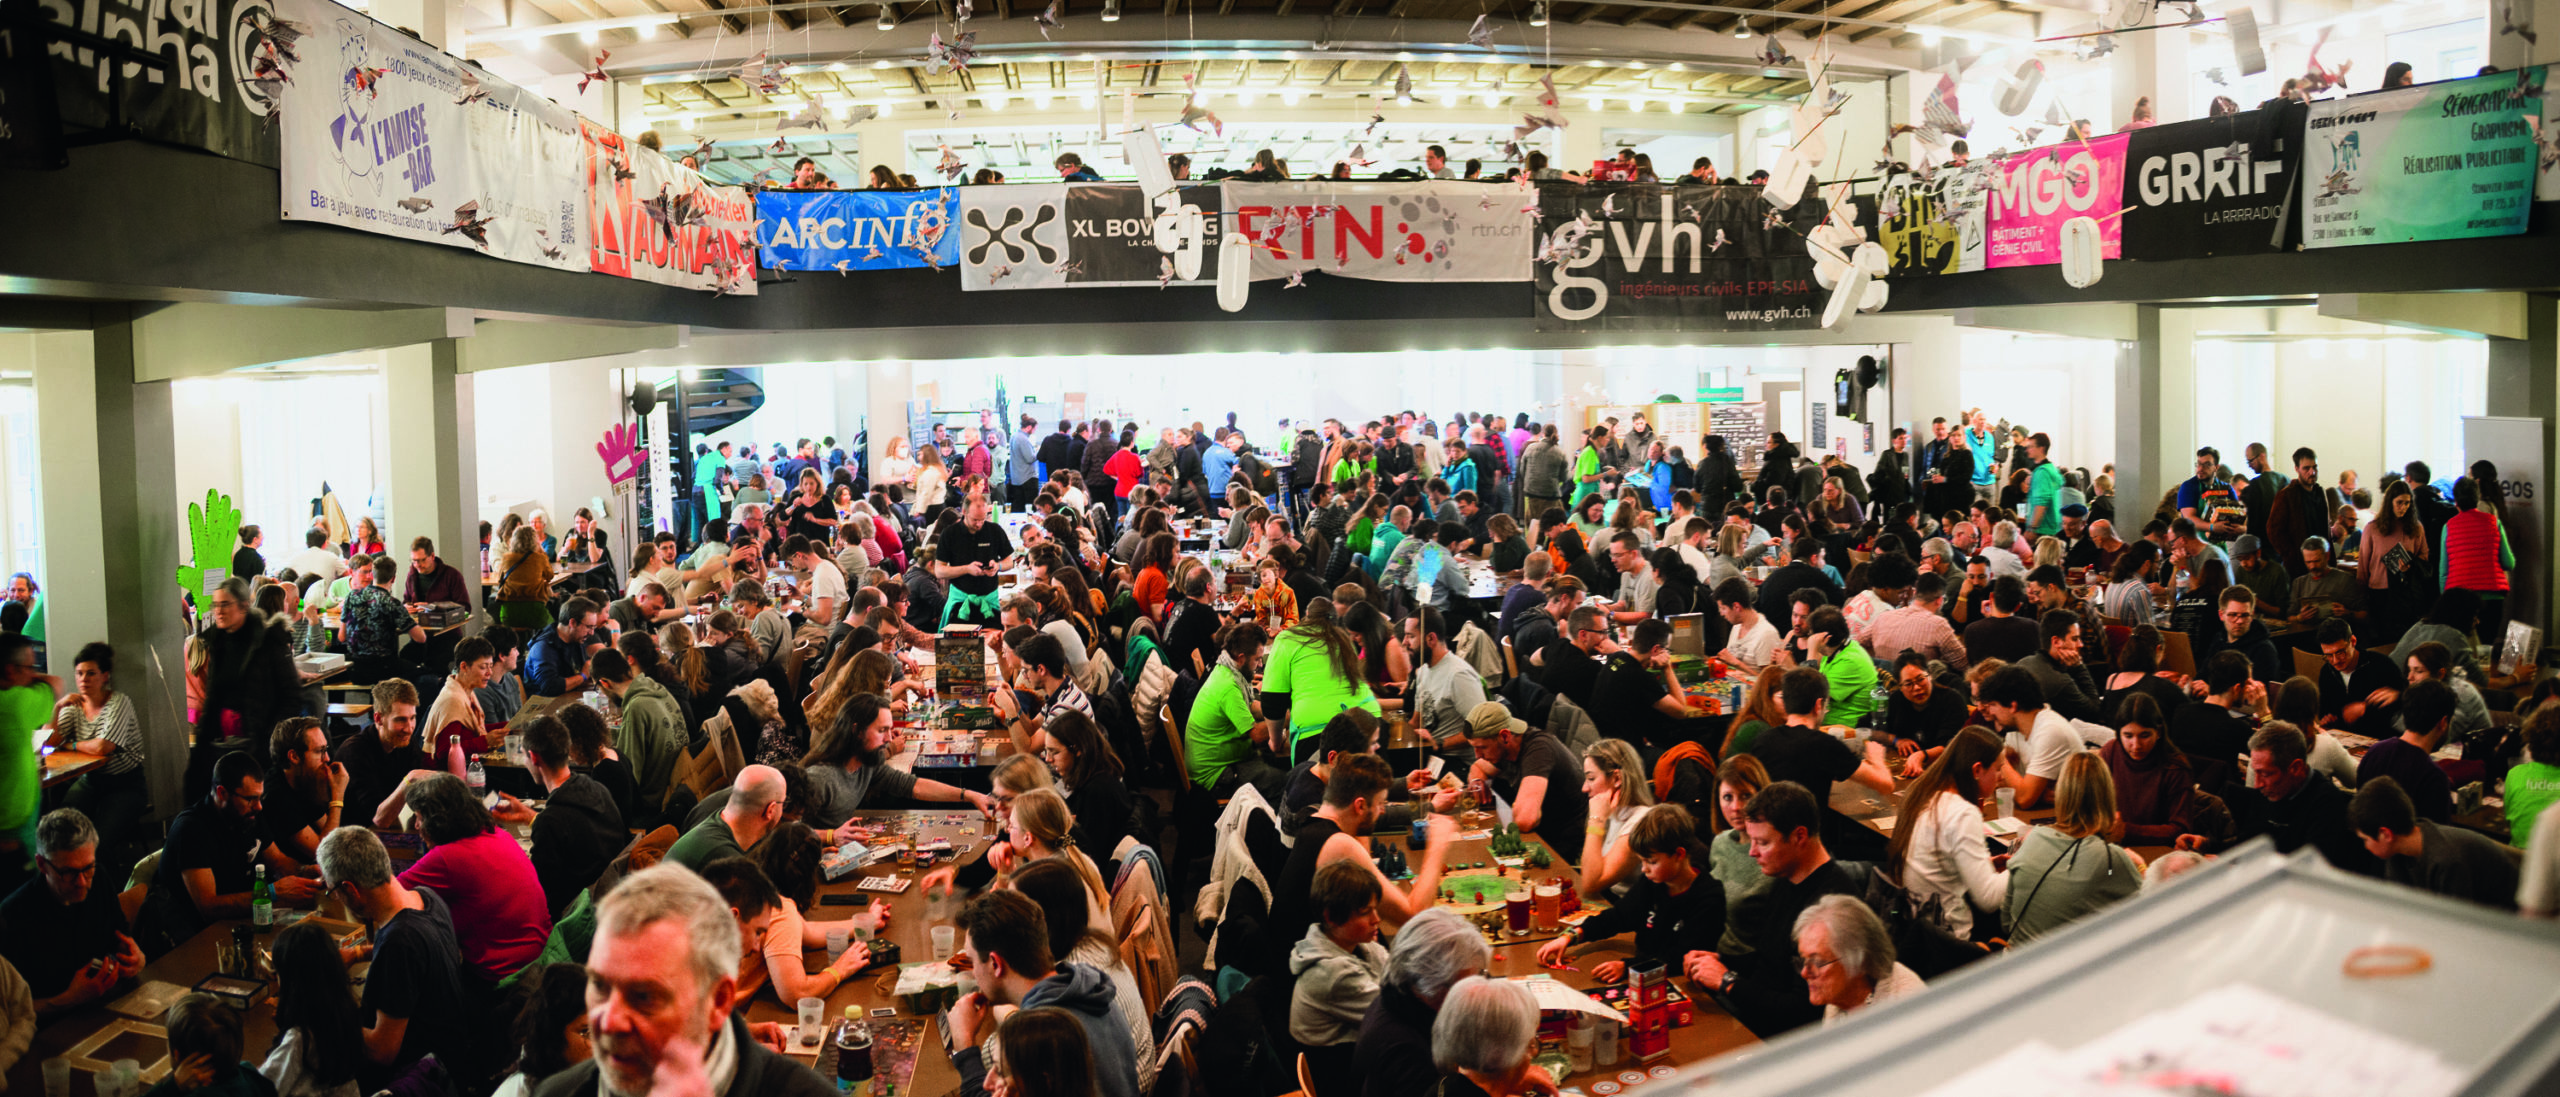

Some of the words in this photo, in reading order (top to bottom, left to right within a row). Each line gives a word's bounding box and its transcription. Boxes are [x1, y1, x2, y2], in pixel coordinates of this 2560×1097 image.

[408, 63, 426, 82] jeux
[427, 72, 437, 88] de
[370, 102, 430, 167] L'AMUSE
[1992, 151, 2100, 221] MGO
[310, 190, 328, 208] Bar
[355, 204, 378, 221] avec
[378, 208, 426, 230] restauration
[427, 216, 438, 232] du
[2204, 212, 2219, 225] LA
[2222, 204, 2283, 223] RRRRADIO
[1072, 219, 1101, 238] XL
[1239, 205, 1384, 262] RTN
[1471, 221, 1523, 238] rtn.ch
[1127, 239, 1139, 247] LA
[2021, 240, 2045, 255] CIVIL
[1548, 194, 1703, 322] gvh
[1620, 280, 1700, 300] ingénieurs
[1704, 280, 1743, 297] civils
[1747, 279, 1810, 296] EPF-SIA
[1726, 305, 1812, 323] www.gvh.ch
